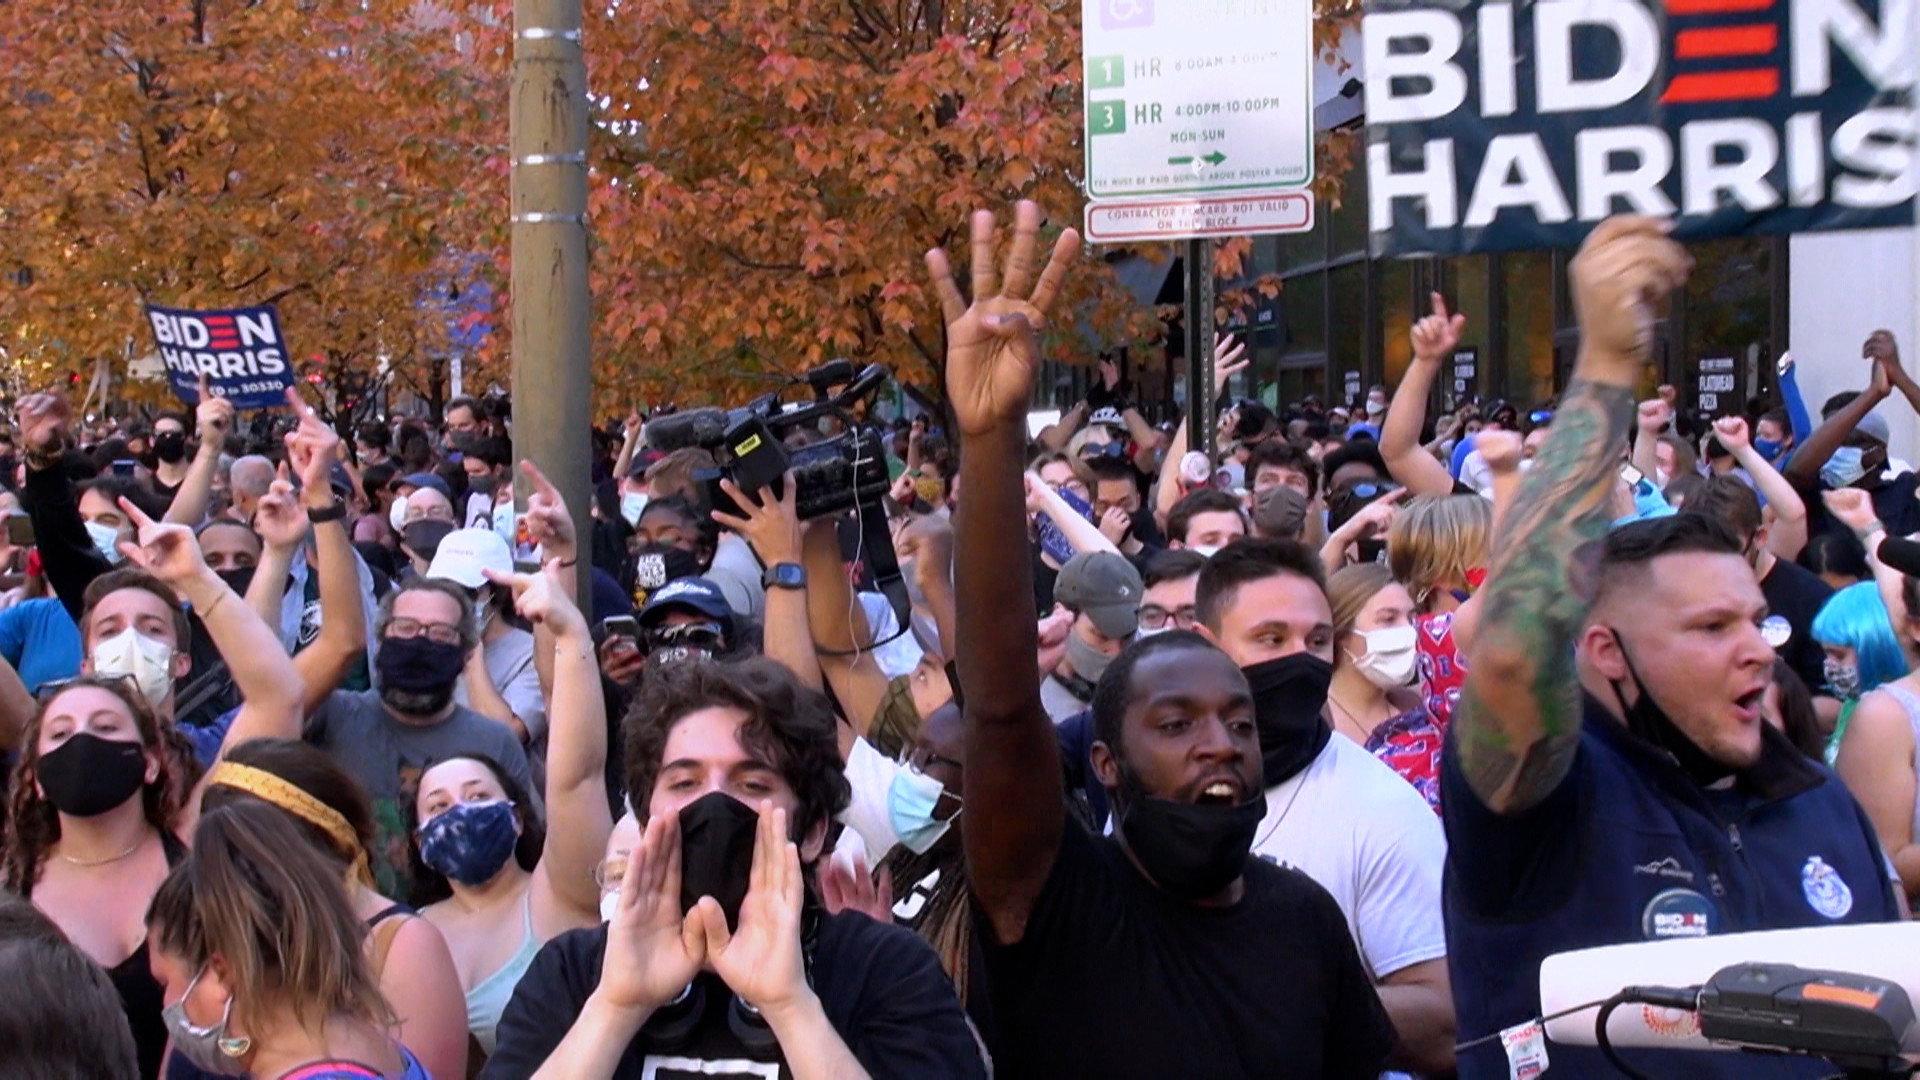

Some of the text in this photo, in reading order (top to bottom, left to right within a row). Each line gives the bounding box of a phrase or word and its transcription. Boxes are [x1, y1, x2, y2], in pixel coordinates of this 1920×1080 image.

[1102, 60, 1112, 82] 1
[1134, 58, 1161, 79] HR
[1362, 0, 1918, 124] BIDEN
[1103, 106, 1114, 128] 3
[1135, 103, 1162, 124] HR
[1150, 176, 1169, 185] PAID
[1209, 172, 1235, 182] ABOVE
[1239, 169, 1271, 179] POSTED
[1275, 167, 1303, 176] HOURS
[1367, 108, 1919, 232] HARRIS
[1107, 202, 1289, 219] CONTRACTOR PCARD NOT VALID
[1157, 221, 1172, 229] ON
[1205, 216, 1238, 227] BLOCK
[150, 311, 277, 348] BIDEN
[161, 347, 285, 379] HARRIS
[1655, 912, 1707, 926] BIDEN
